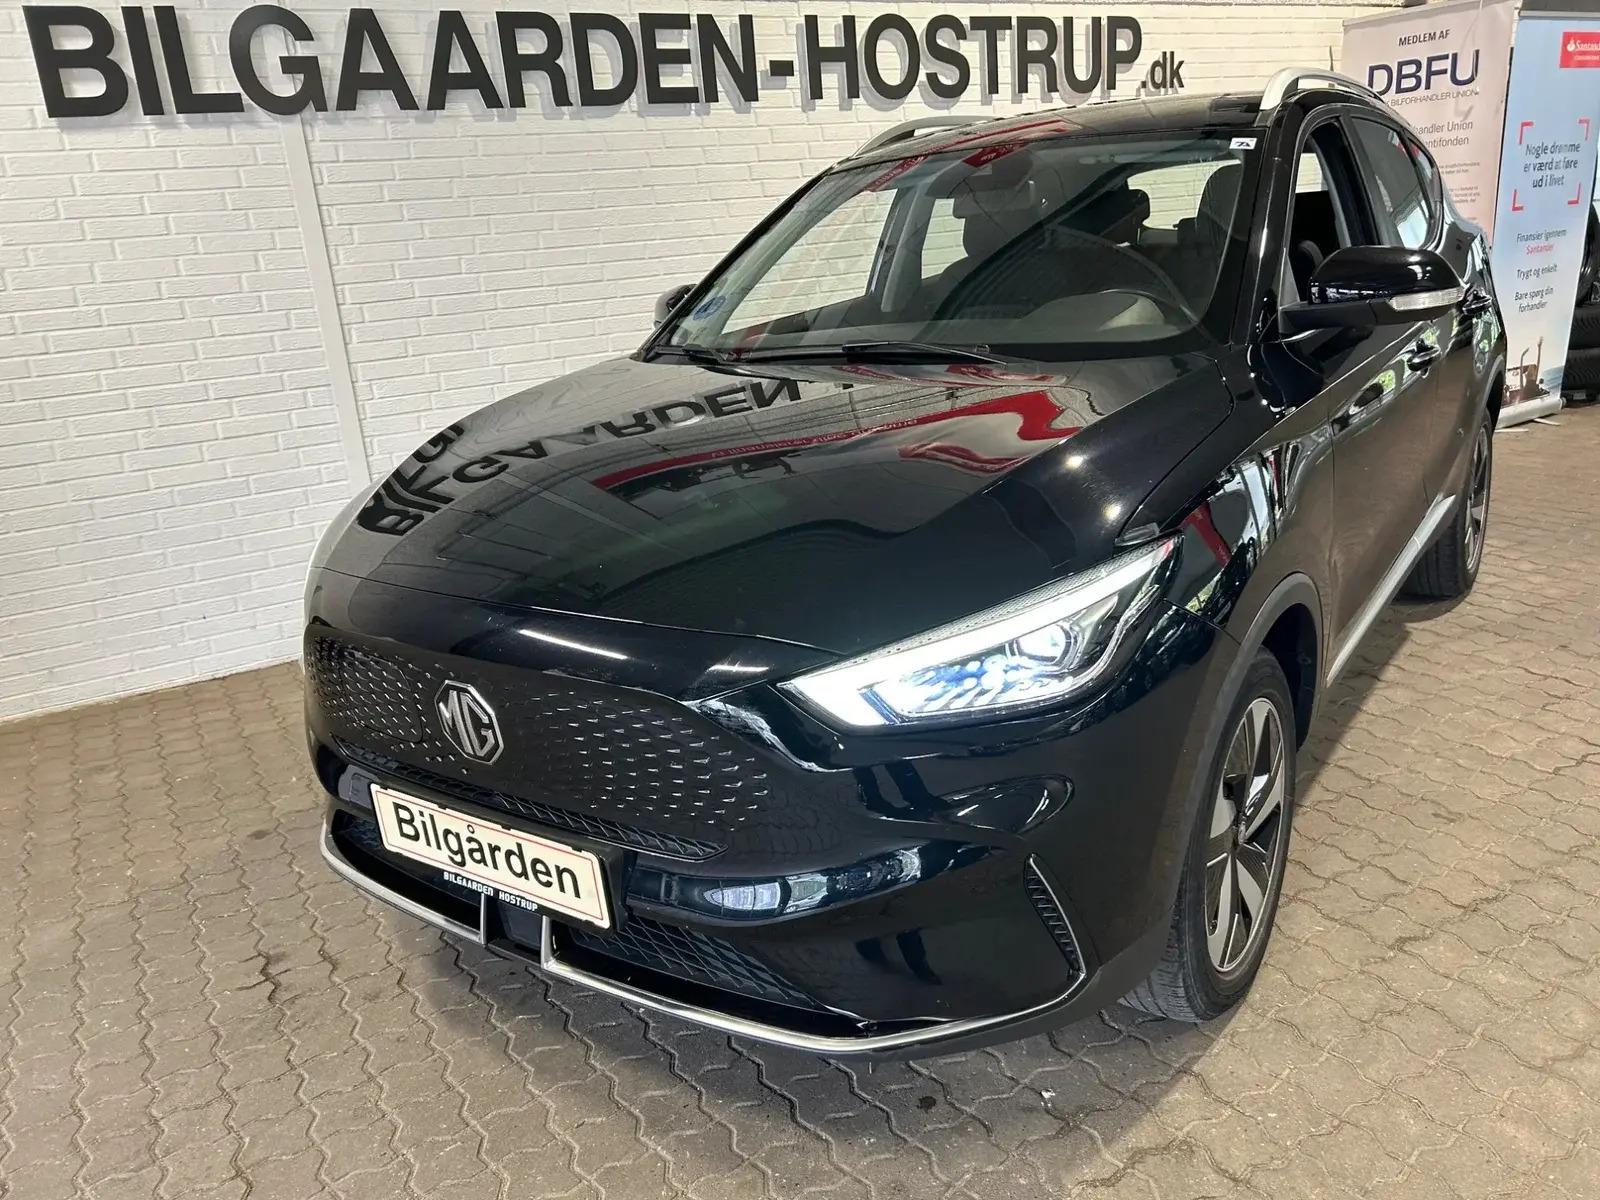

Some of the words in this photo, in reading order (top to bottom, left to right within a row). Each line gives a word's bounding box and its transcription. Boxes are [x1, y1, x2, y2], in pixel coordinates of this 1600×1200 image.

[1398, 31, 1437, 47] MEDLEM
[1438, 29, 1451, 40] AF
[1367, 49, 1480, 96] DBFU
[1390, 92, 1451, 106] BILFORHANDLER
[1447, 120, 1473, 132] Union
[1525, 143, 1548, 159] Nogle
[1549, 142, 1581, 154] drømme
[1523, 163, 1532, 172] er
[1532, 160, 1554, 172] værd
[1554, 161, 1562, 169] at
[1532, 177, 1543, 188] ud
[1544, 176, 1549, 187] i
[1549, 175, 1565, 187] livet
[1516, 230, 1544, 243] Finansier
[1544, 228, 1567, 241] igennem
[1516, 269, 1533, 280] Trygt
[1533, 268, 1541, 278] og
[1541, 264, 1558, 274] enkelt
[1514, 291, 1528, 301] Bare
[1544, 286, 1554, 296] din
[1518, 300, 1548, 313] forhandler
[439, 689, 494, 757] MG
[391, 800, 582, 899] Bilgården
[443, 870, 494, 897] BILGAARDEN
[498, 890, 539, 912] HOSTRUP
